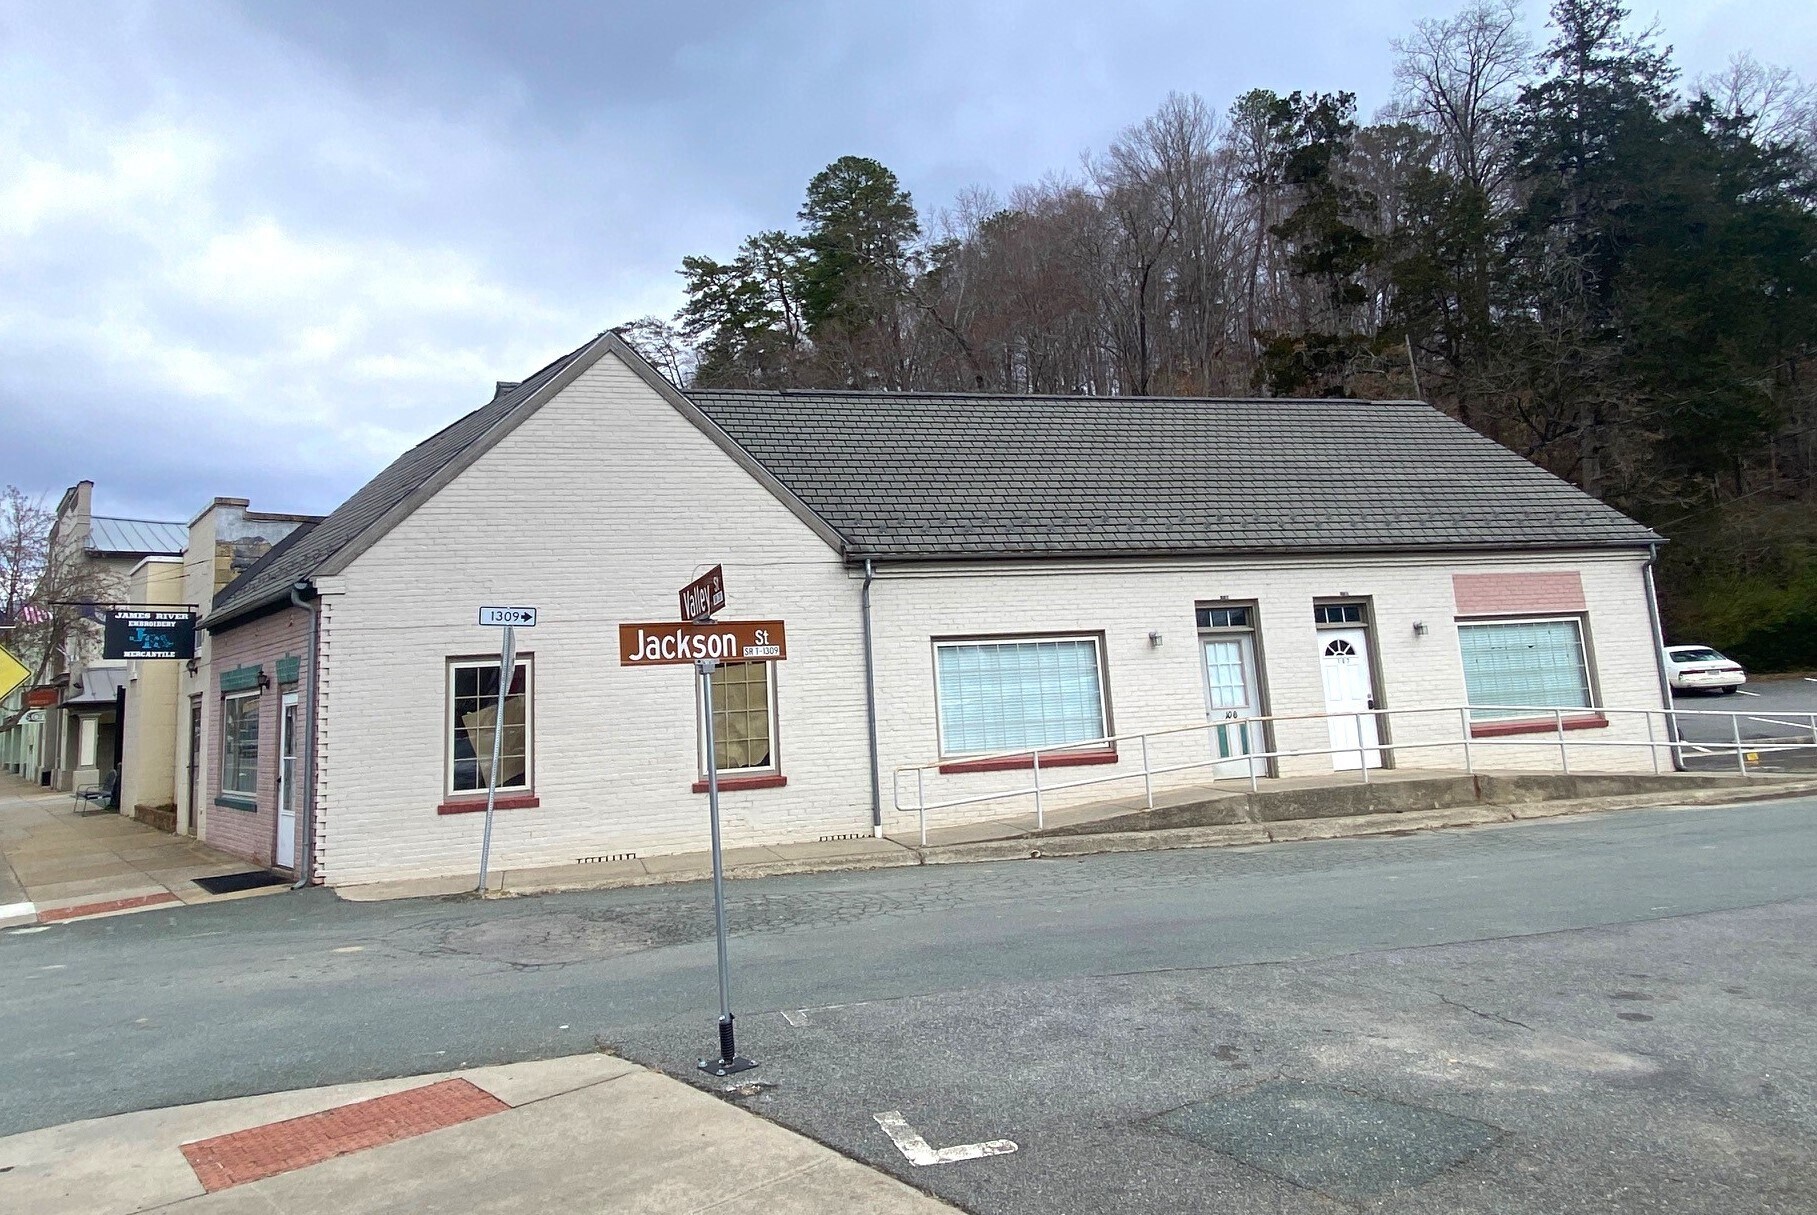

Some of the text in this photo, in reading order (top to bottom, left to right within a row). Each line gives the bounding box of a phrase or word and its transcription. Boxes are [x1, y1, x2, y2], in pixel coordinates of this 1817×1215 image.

[683, 584, 710, 619] Valley
[713, 576, 720, 592] St
[491, 611, 519, 622] 1309
[628, 628, 769, 661] Jackson St
[744, 647, 754, 656] SR
